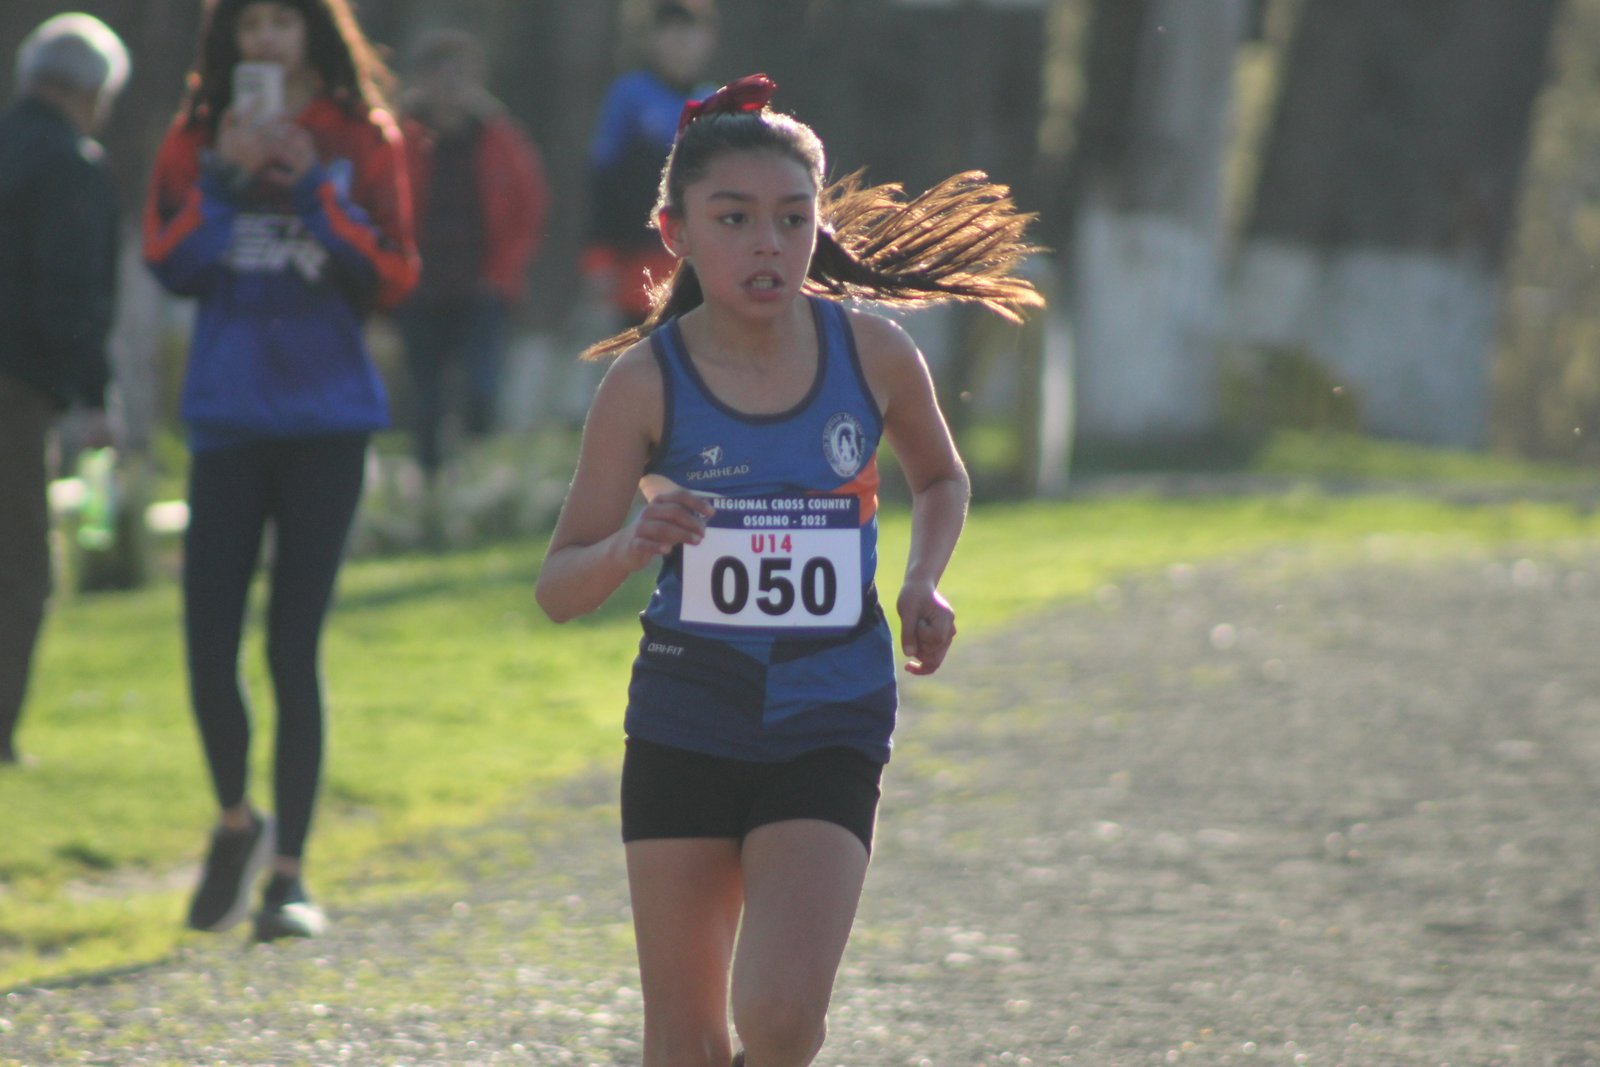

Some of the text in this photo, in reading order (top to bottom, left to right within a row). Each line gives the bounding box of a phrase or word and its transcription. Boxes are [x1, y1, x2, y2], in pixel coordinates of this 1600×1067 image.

[686, 464, 749, 481] SPEARHEAD
[713, 498, 851, 509] REGIONAL CROSS COUNTRY
[743, 515, 789, 526] OSORNO
[800, 515, 827, 526] 2025
[751, 534, 792, 553] U14
[711, 555, 837, 615] 050
